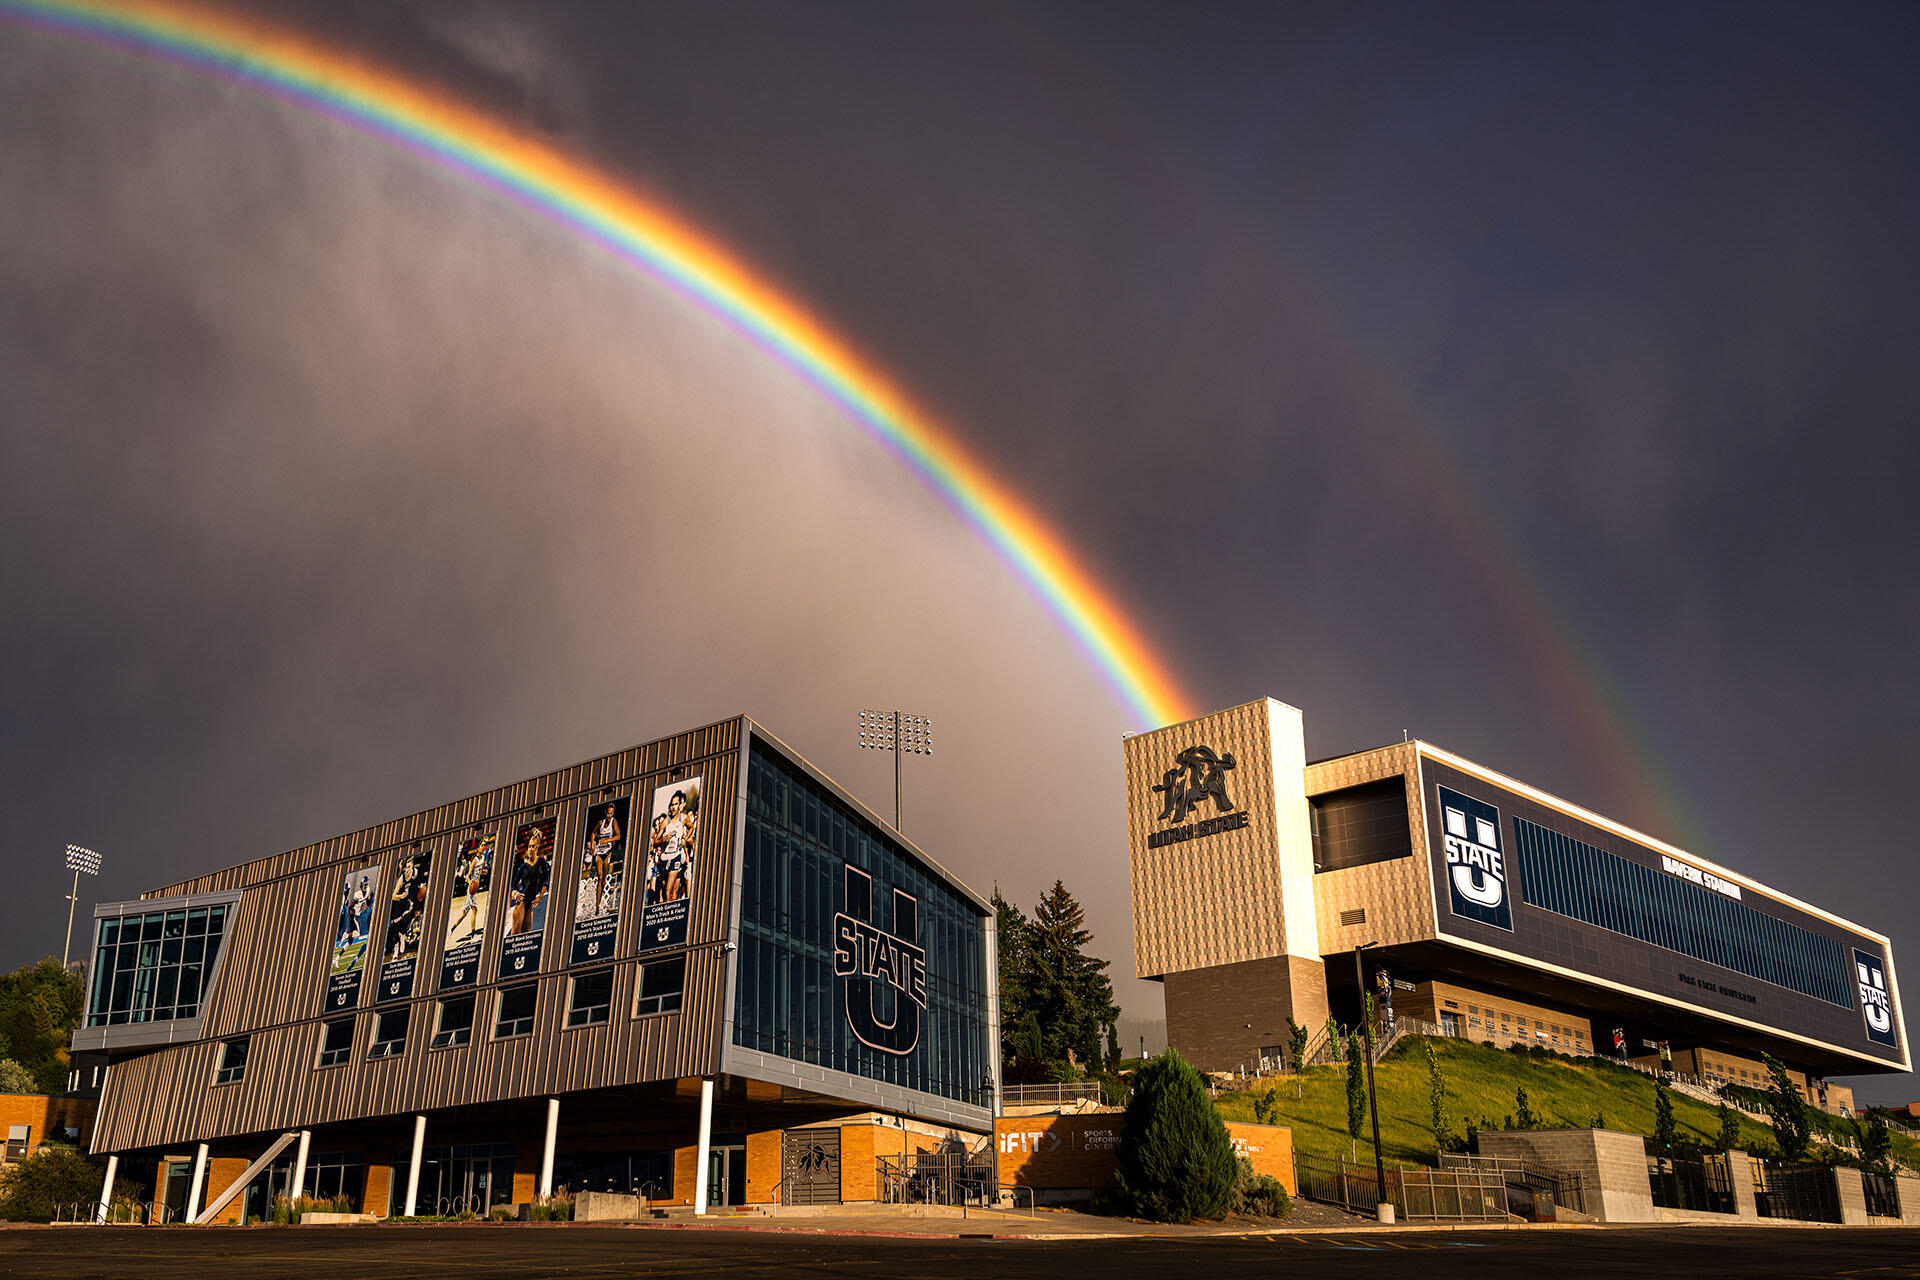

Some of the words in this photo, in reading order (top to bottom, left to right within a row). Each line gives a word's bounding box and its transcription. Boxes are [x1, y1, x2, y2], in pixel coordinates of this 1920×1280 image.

[1147, 824, 1194, 850] UTAH
[1195, 810, 1251, 839] STATE
[1444, 834, 1504, 883] STATE
[1446, 806, 1503, 909] U
[651, 905, 664, 913] Caleb
[675, 906, 686, 914] Field
[834, 912, 926, 1010] STATE
[845, 863, 920, 1056] U
[1859, 982, 1890, 1014] STATE
[1000, 1132, 1043, 1153] iFIT
